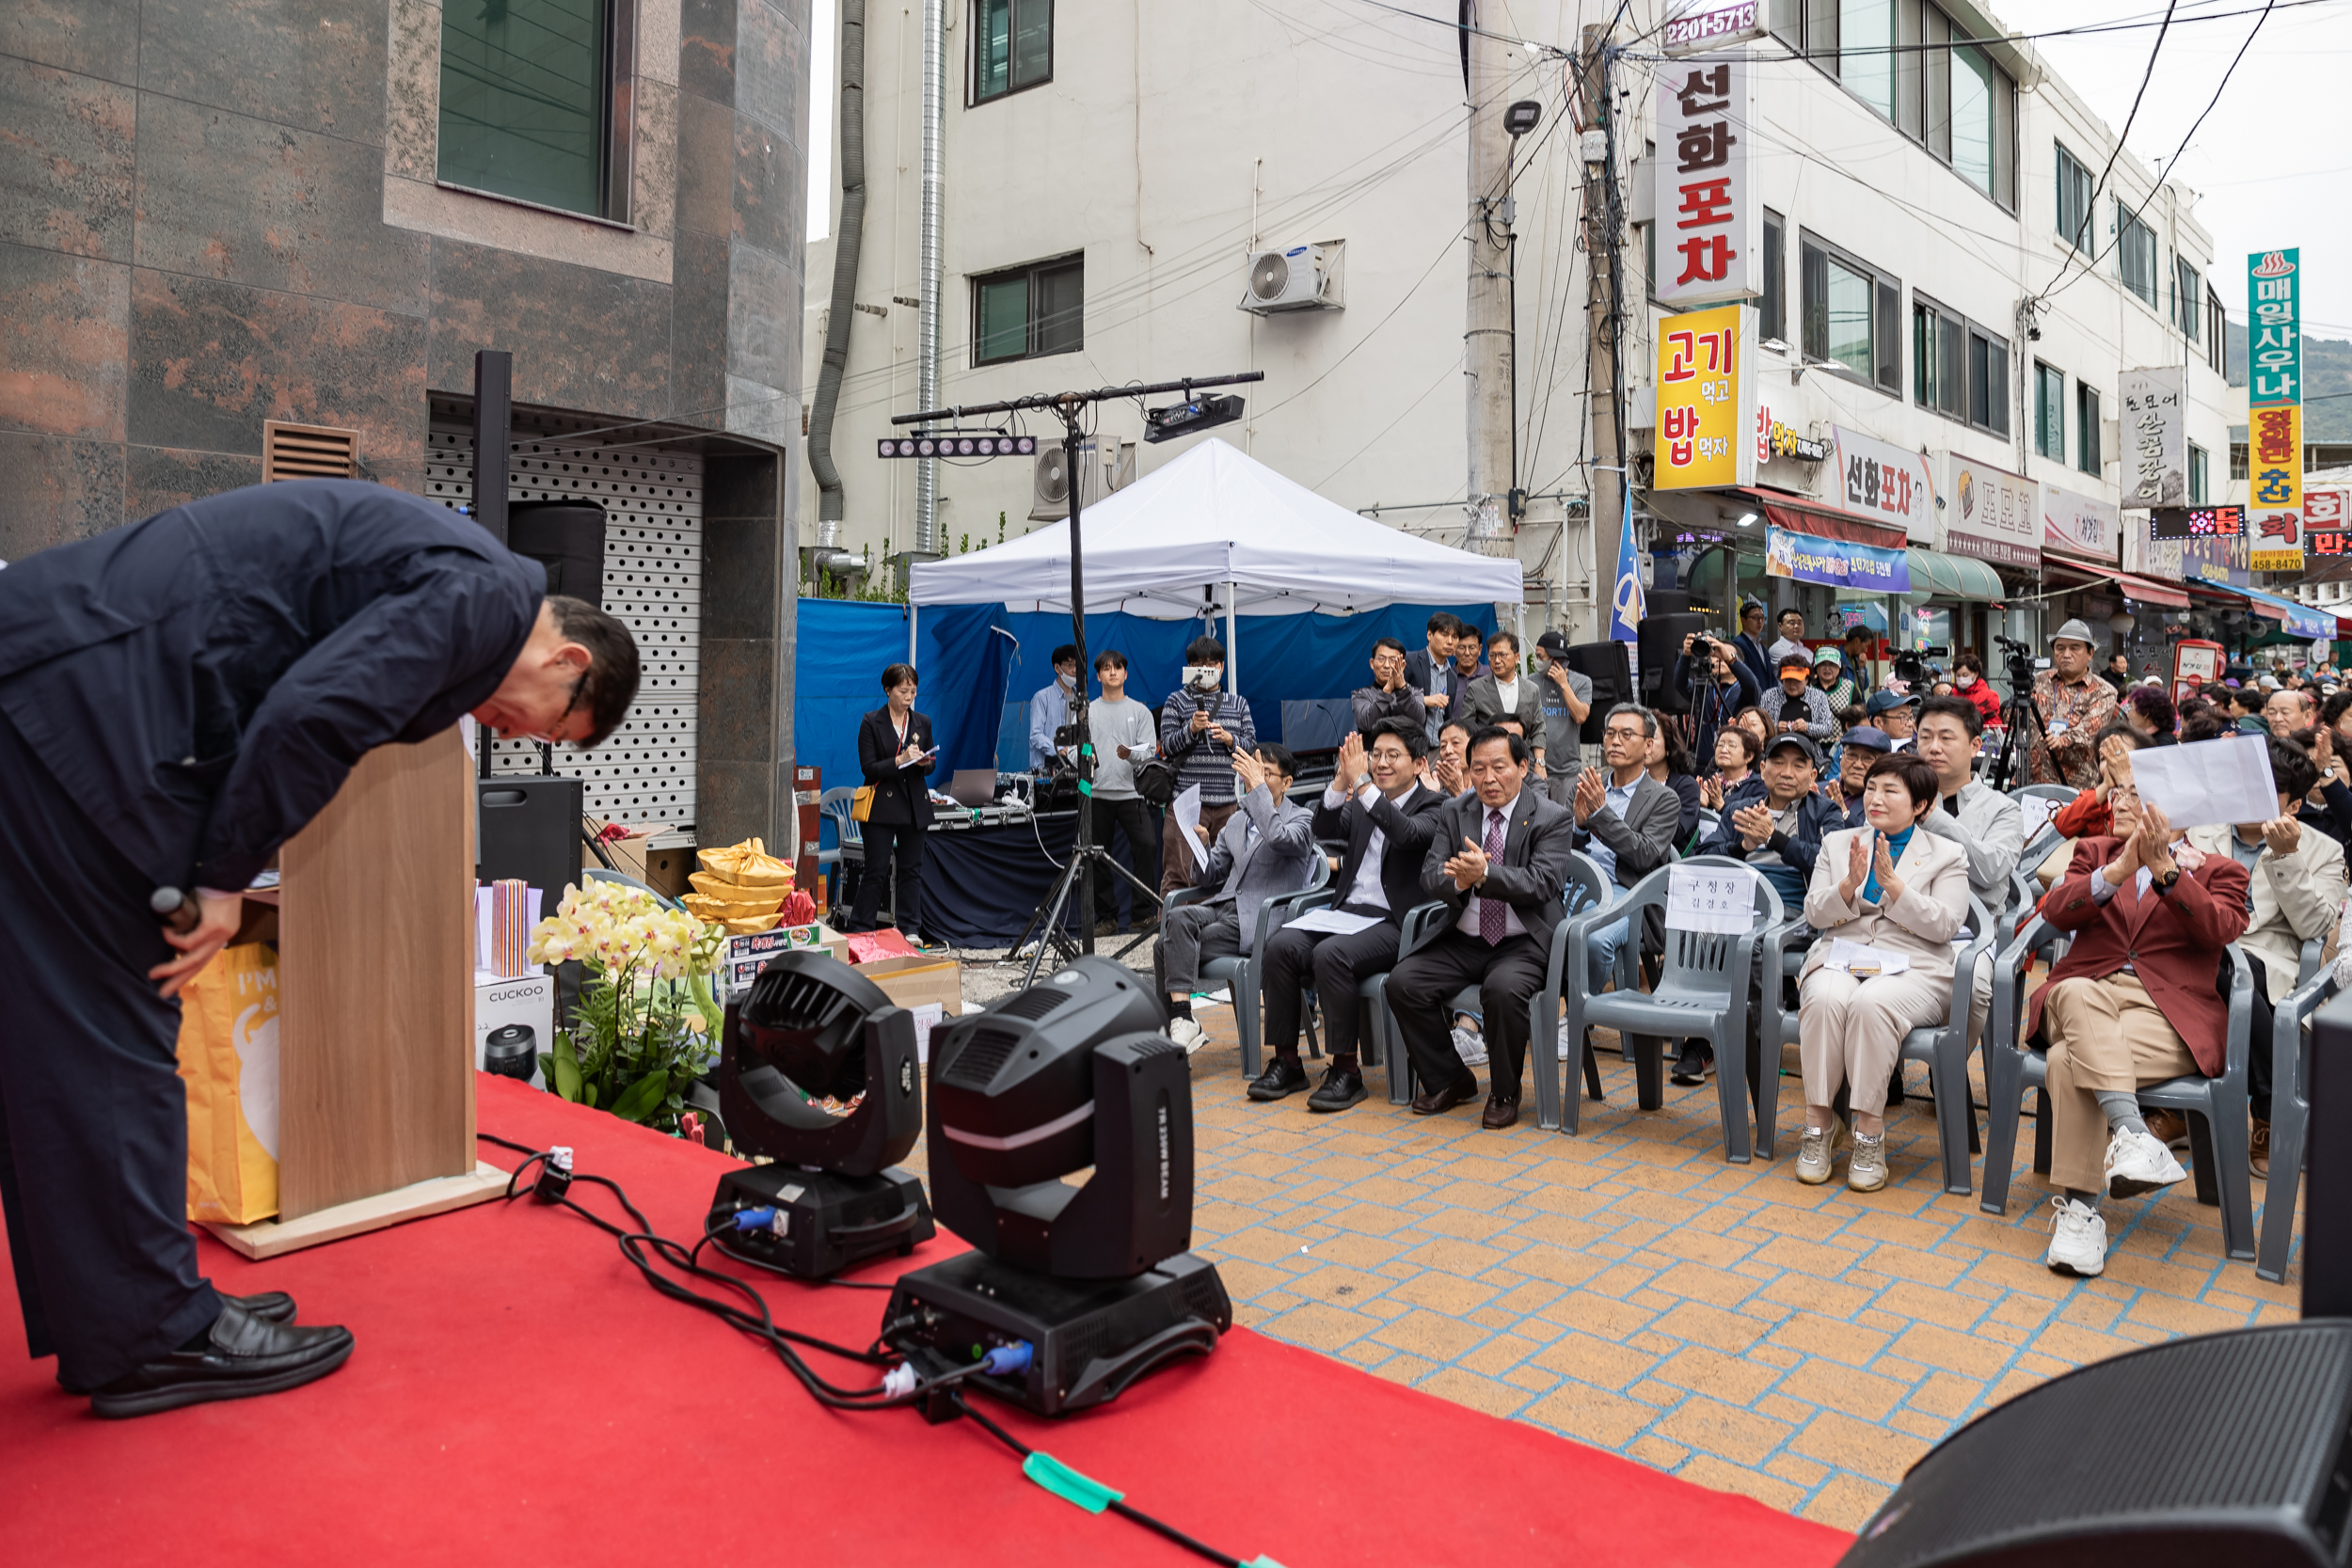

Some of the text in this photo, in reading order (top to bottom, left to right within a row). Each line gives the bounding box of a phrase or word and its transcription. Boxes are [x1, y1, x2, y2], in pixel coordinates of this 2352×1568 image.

[1666, 4, 1755, 44] 2201-5713
[1677, 63, 1737, 286] 선화포차
[2255, 277, 2297, 396] 매일사우나
[1663, 327, 1732, 382] 고기
[1701, 379, 1729, 406] 먹고
[1663, 404, 1728, 467] 밥 먹자
[1773, 421, 1797, 456] 먹자
[1848, 454, 1912, 515] 선화포차
[2256, 468, 2293, 503] 수산
[2304, 490, 2349, 529] 회
[2259, 513, 2298, 545] 회
[2315, 532, 2352, 553] 만
[2252, 559, 2301, 570] 458-8470
[1844, 612, 1864, 626] OPEN
[238, 969, 277, 996] I'M
[489, 986, 544, 1002] CUCKOO
